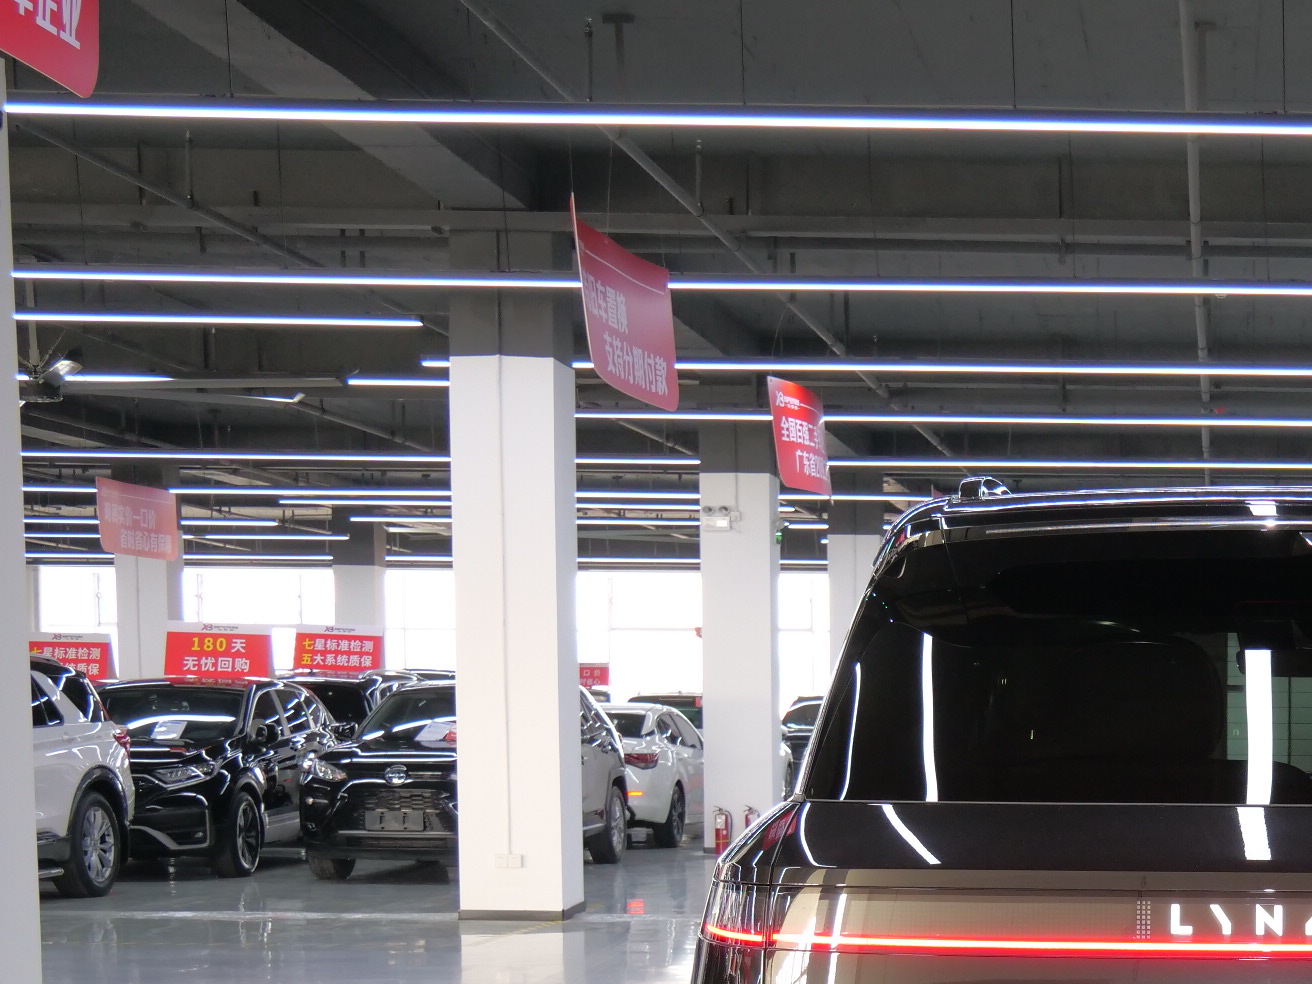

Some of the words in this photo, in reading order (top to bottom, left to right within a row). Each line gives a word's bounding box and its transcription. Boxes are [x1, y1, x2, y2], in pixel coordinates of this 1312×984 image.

[14, 0, 82, 51] 企业
[603, 331, 668, 396] 支持分期付款
[303, 638, 374, 652] 七星标准检测
[183, 656, 250, 673] 无忧回购
[301, 653, 373, 667] 五大系统质保
